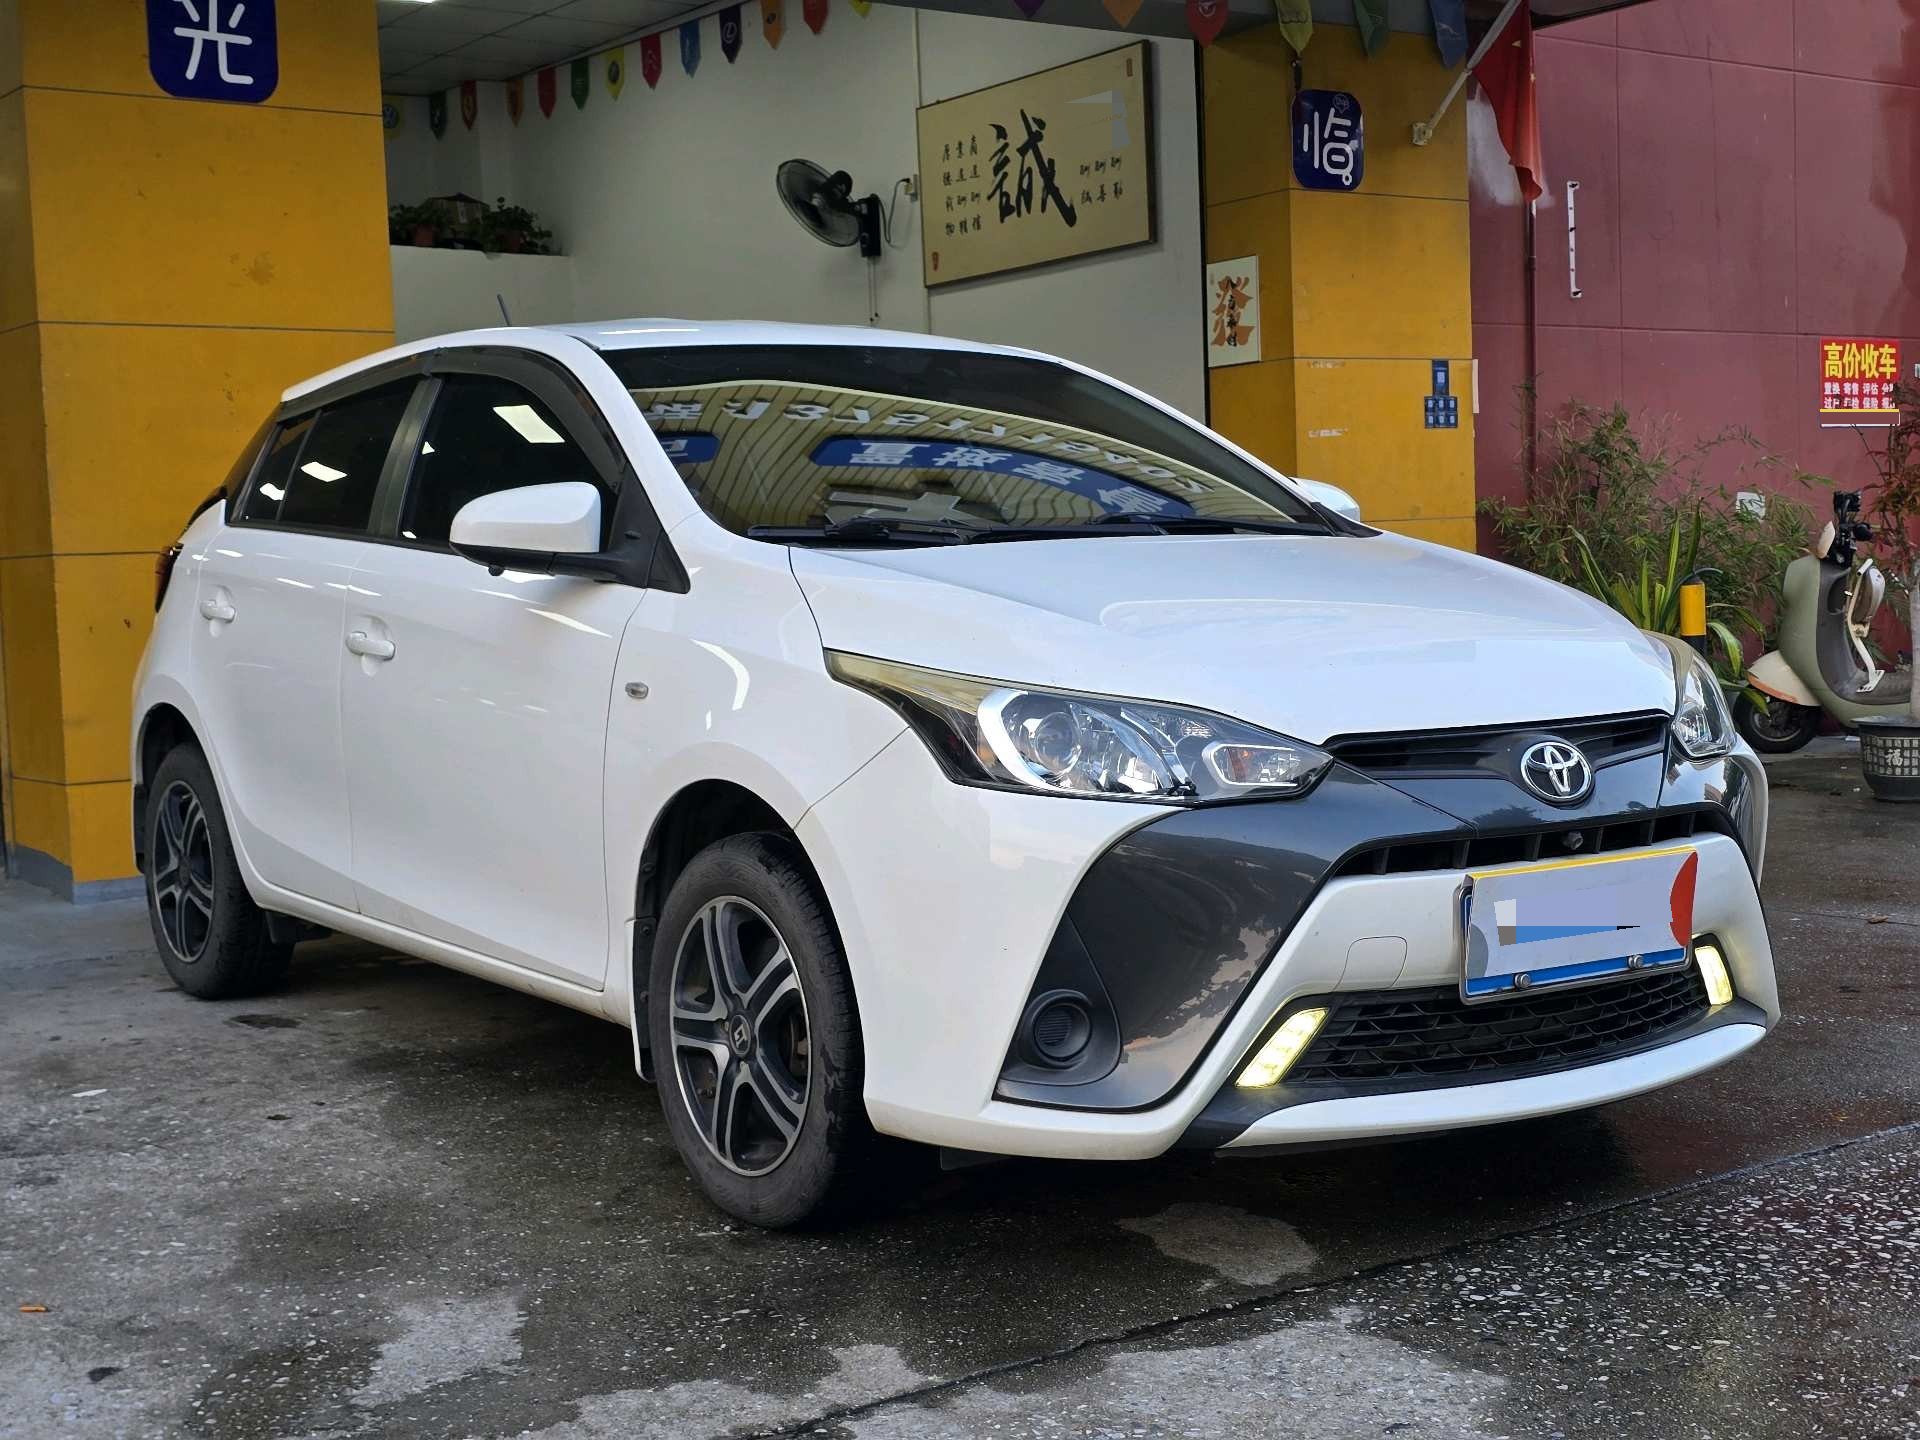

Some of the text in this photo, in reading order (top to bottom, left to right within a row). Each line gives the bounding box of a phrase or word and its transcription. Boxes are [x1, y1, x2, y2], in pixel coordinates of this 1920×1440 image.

[173, 0, 254, 85] 光
[1823, 342, 1897, 379] 高价收车
